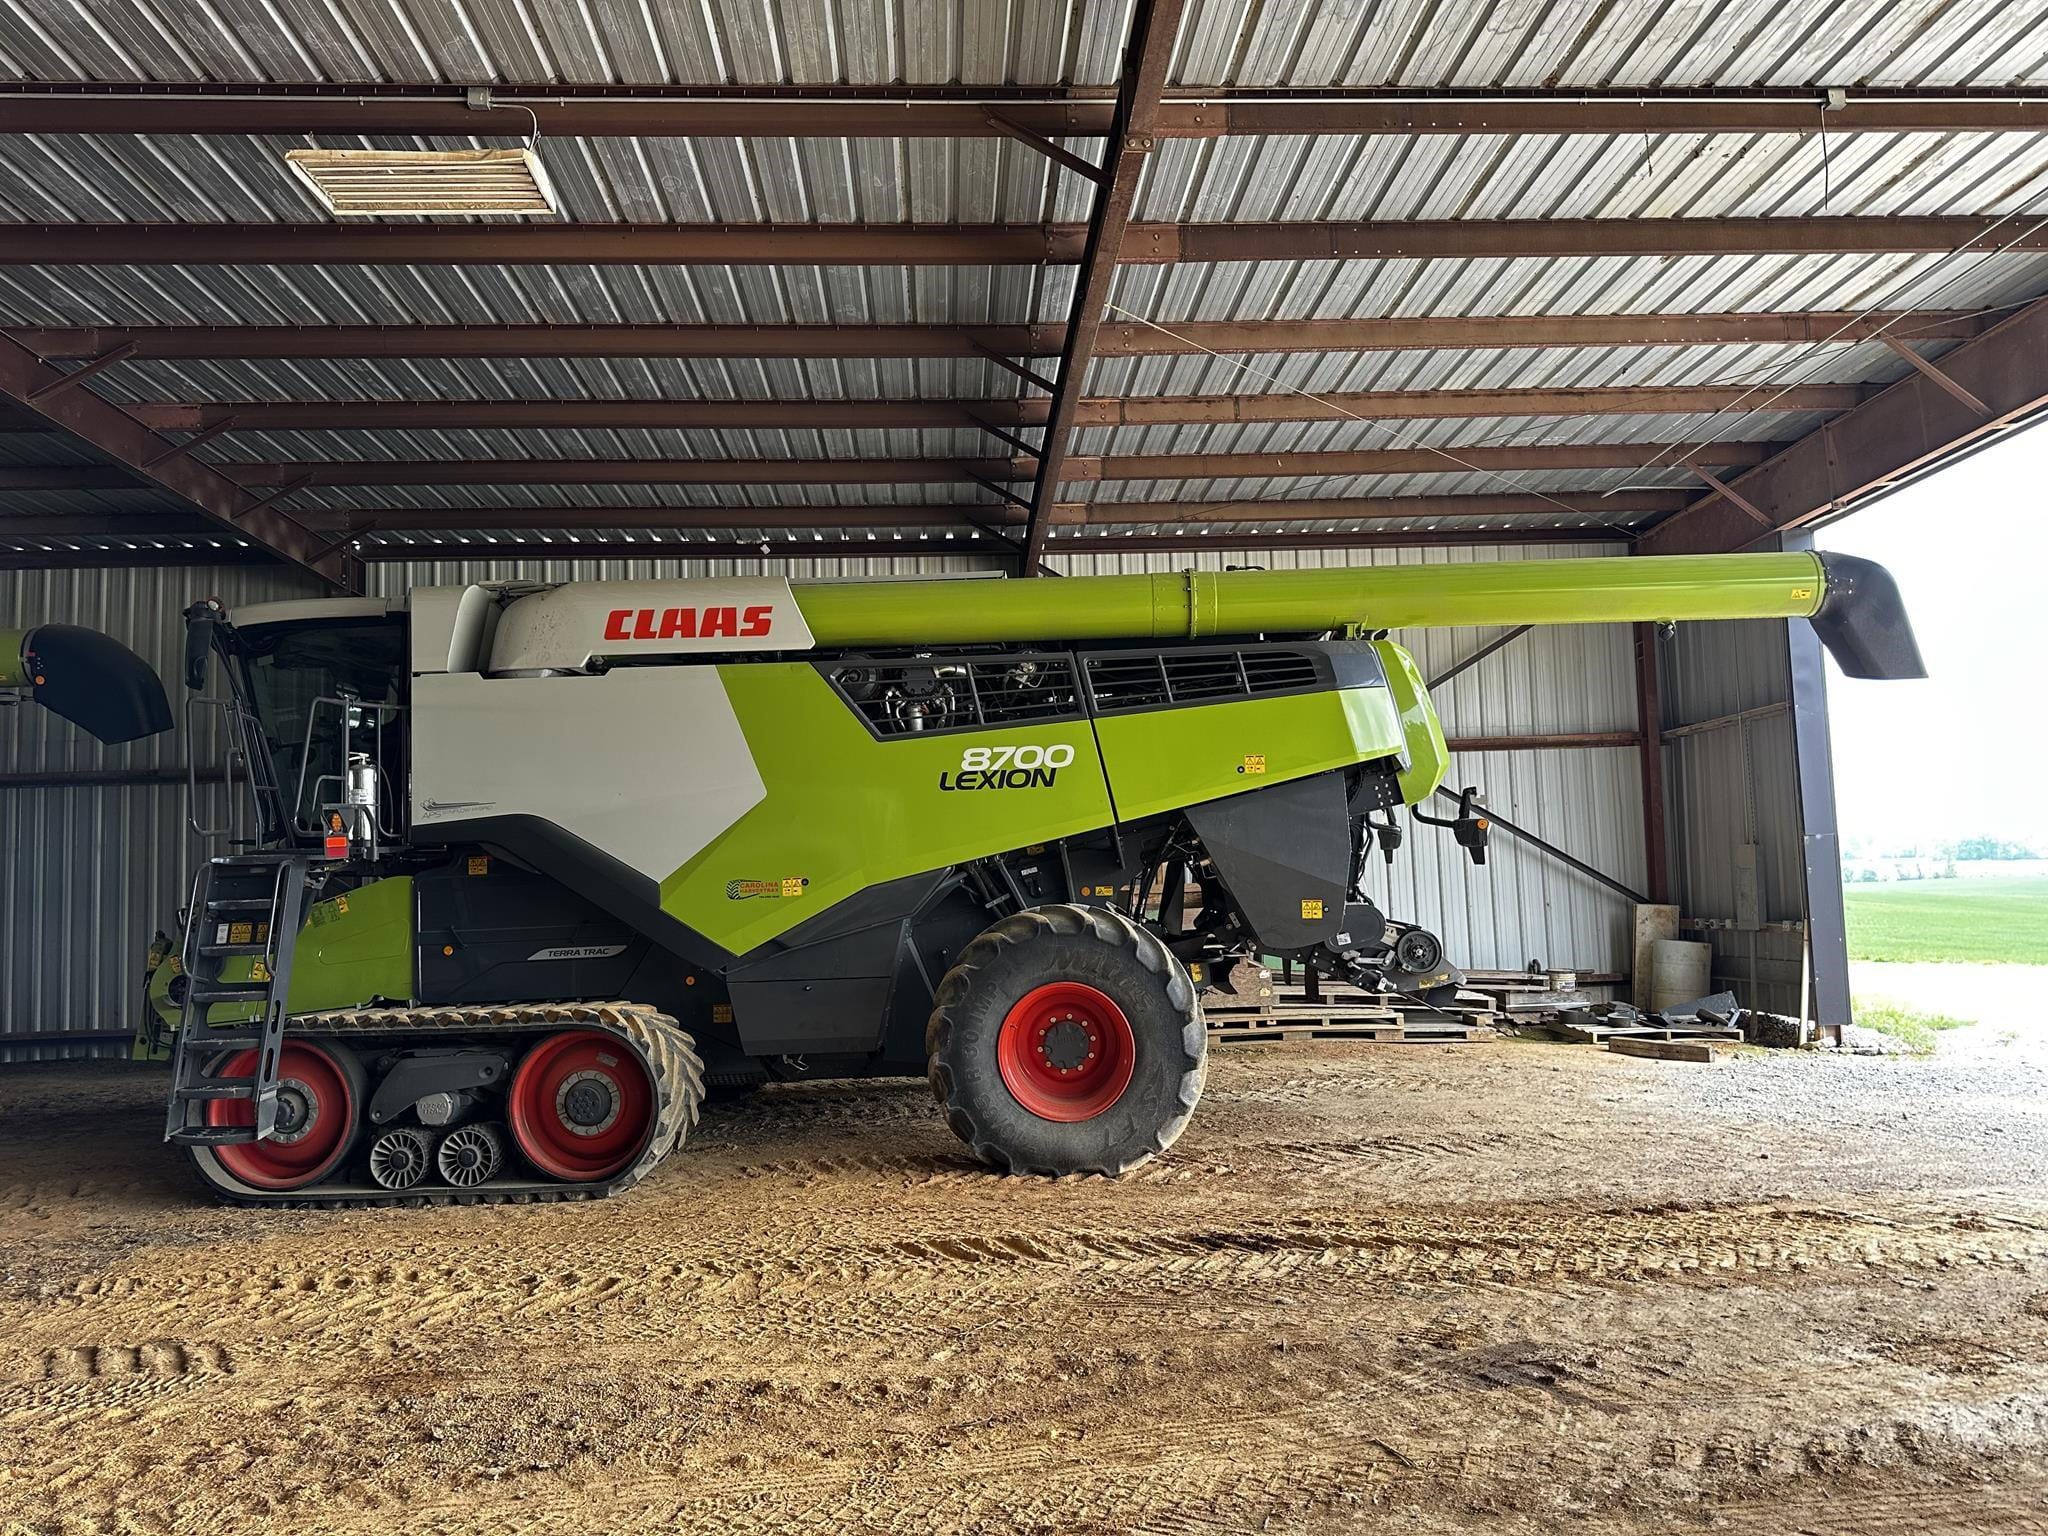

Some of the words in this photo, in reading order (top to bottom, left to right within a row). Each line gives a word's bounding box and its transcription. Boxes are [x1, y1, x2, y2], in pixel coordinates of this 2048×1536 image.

[604, 606, 773, 640] CLAAS
[961, 744, 1075, 771] 8700
[939, 768, 1057, 791] LEXION
[741, 881, 778, 889] CAROLINA
[548, 949, 580, 957] TERRA
[583, 948, 610, 956] TRAC
